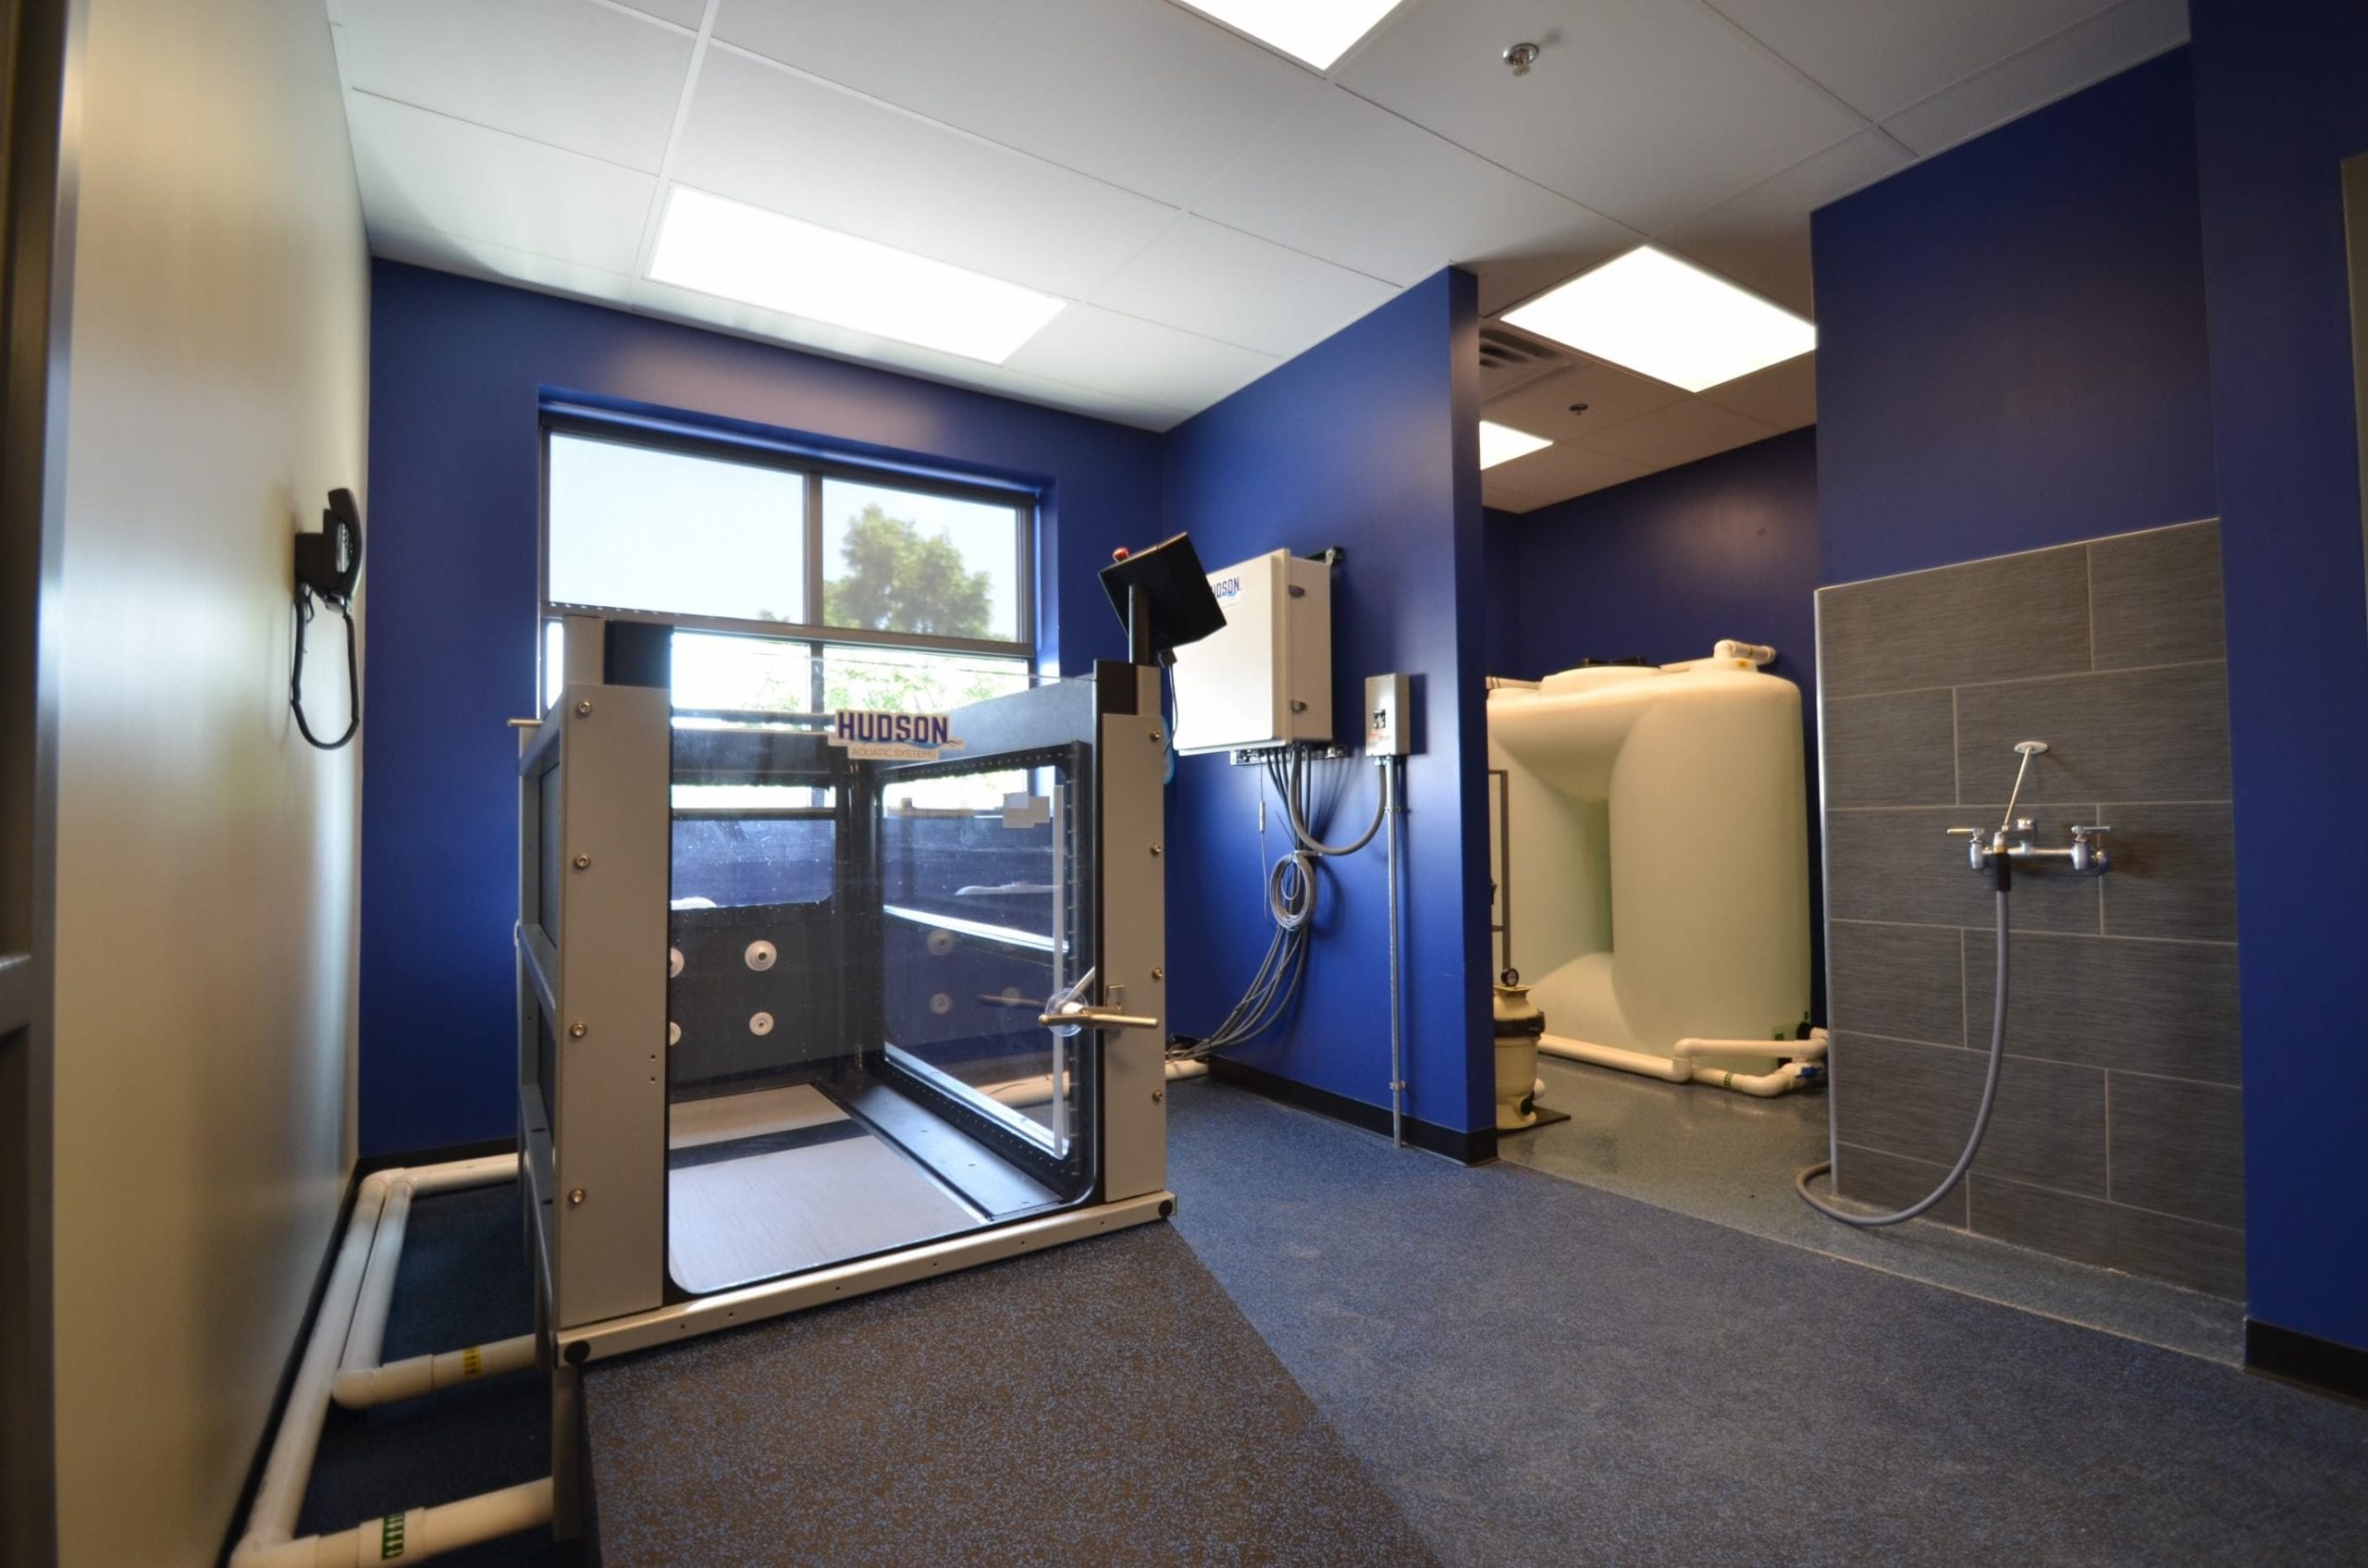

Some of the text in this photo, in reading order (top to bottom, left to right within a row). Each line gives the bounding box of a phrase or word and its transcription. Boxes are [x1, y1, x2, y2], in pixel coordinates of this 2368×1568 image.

[838, 711, 948, 744] HUDSON
[851, 747, 936, 758] AQUATIC SYSTEMS
